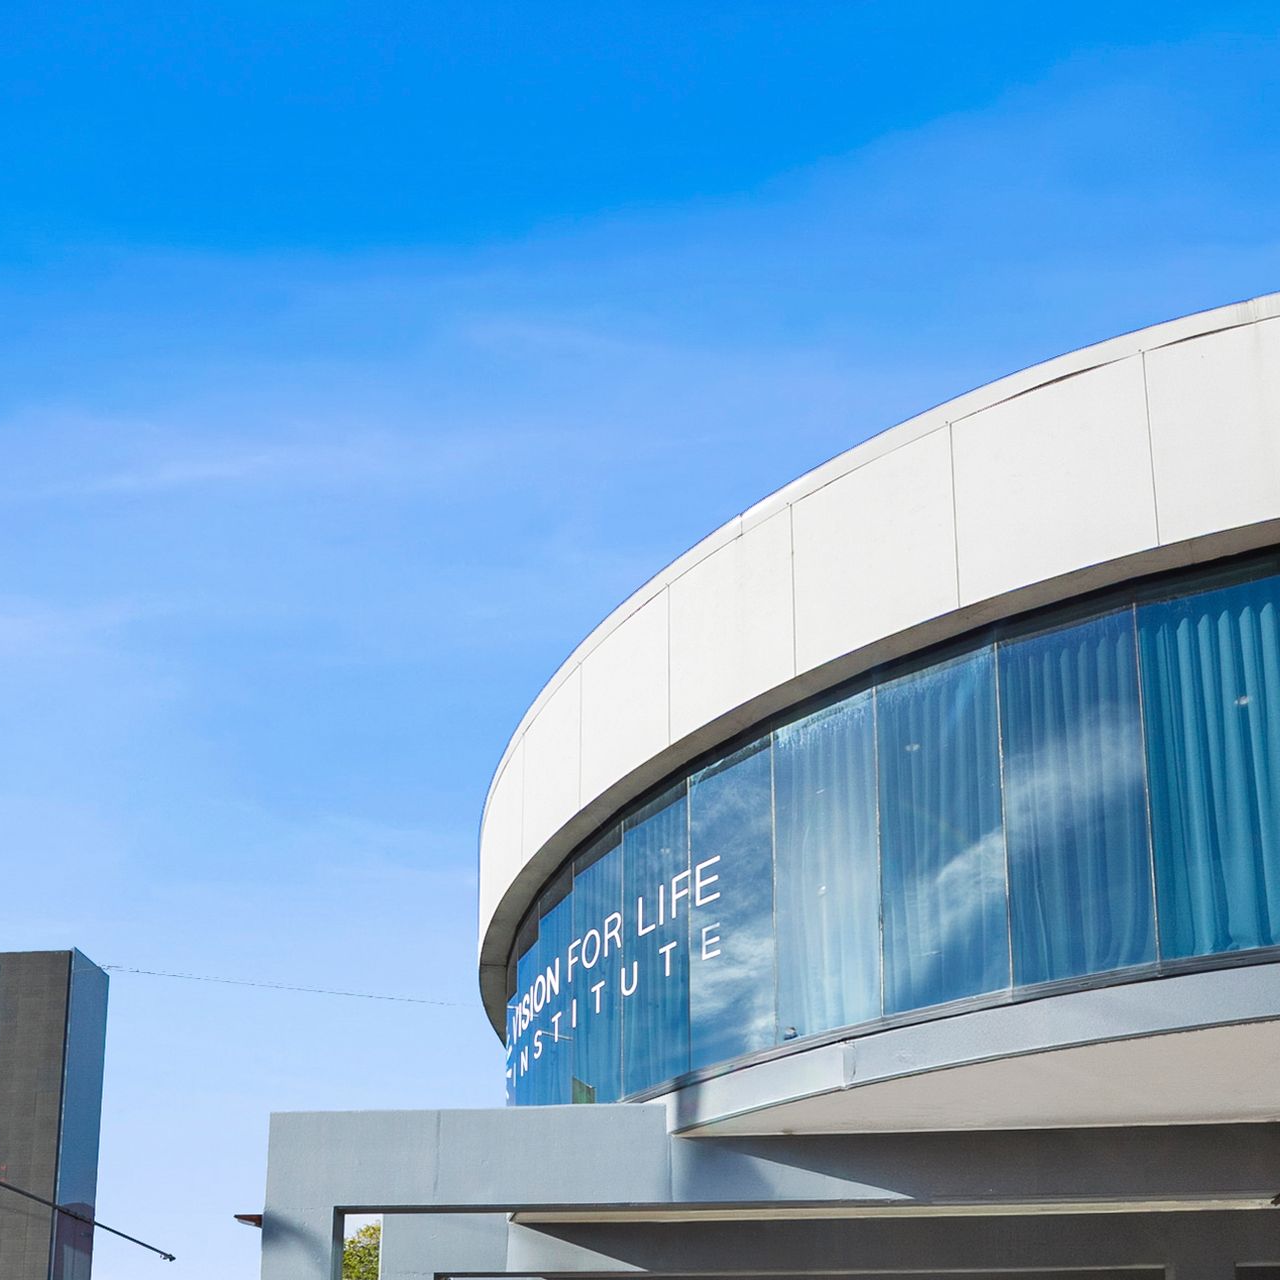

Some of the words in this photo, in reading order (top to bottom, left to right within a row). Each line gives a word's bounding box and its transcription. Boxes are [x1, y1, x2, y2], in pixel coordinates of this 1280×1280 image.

[512, 956, 560, 1044] VISION
[567, 911, 622, 983] FOR
[637, 855, 721, 937] LIFE
[513, 922, 721, 1088] INSTITUTE
